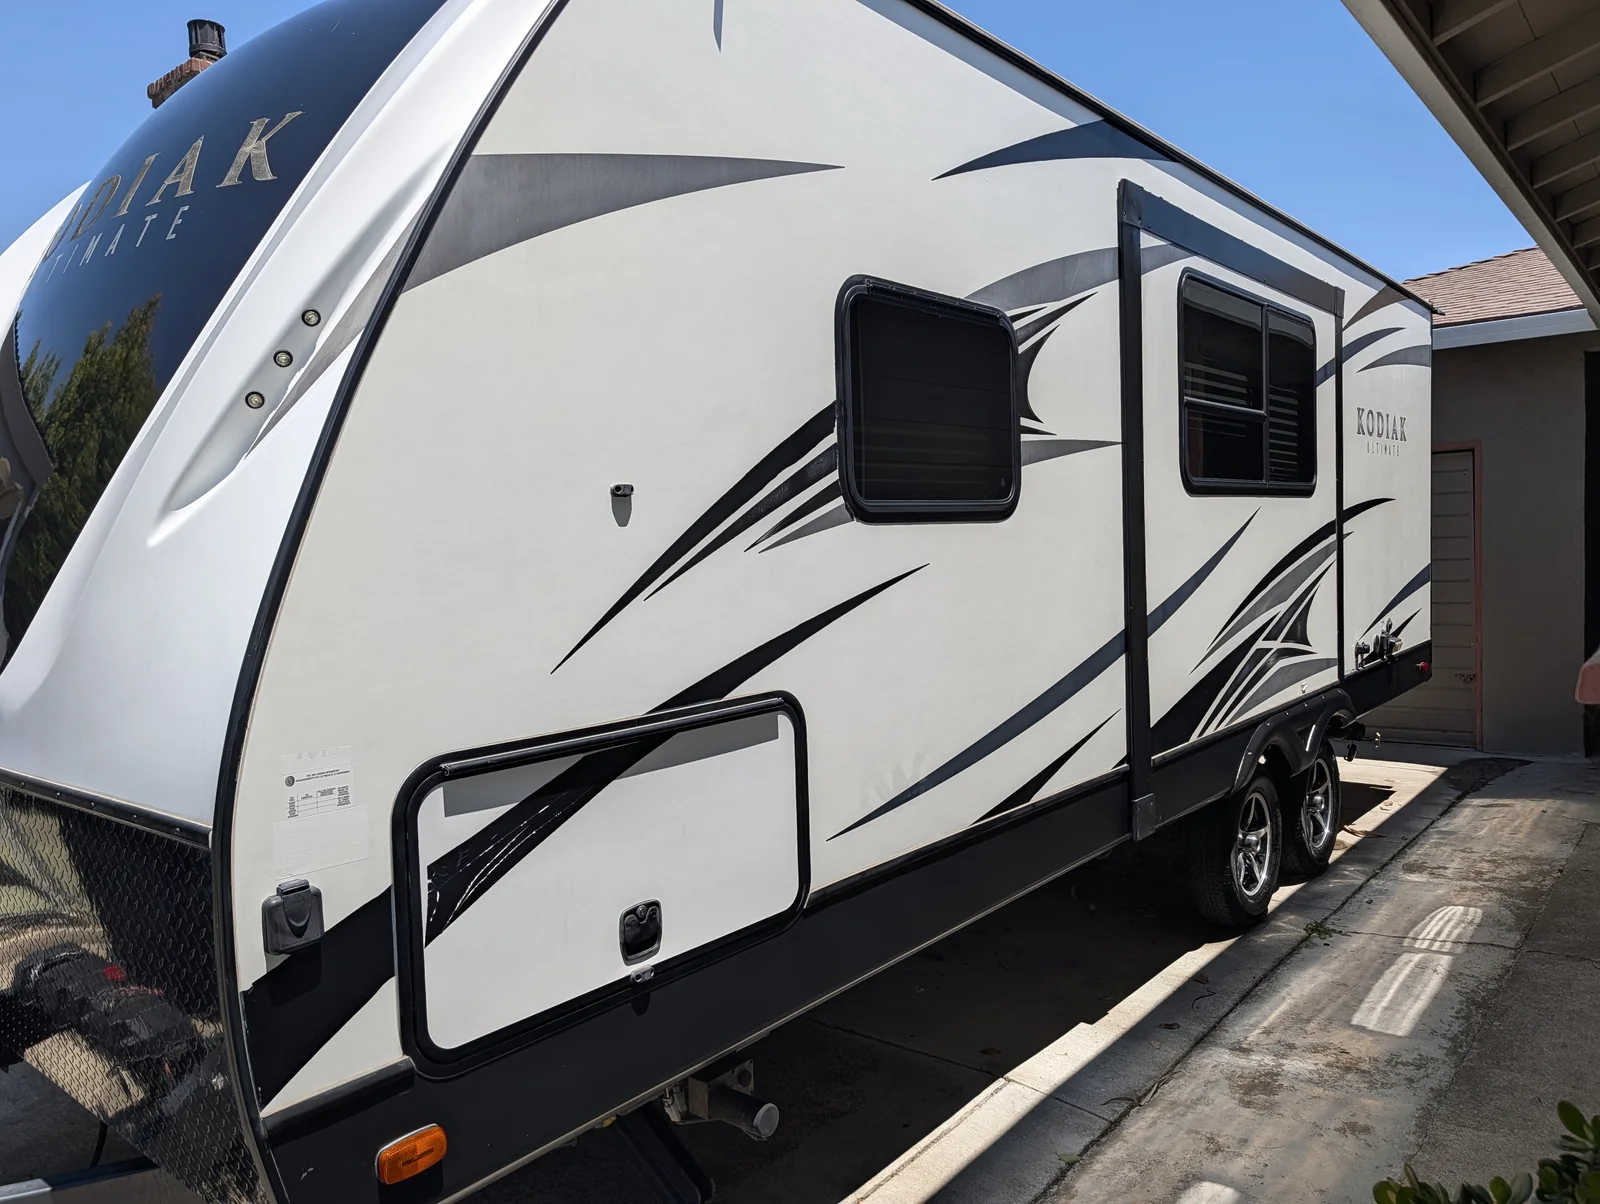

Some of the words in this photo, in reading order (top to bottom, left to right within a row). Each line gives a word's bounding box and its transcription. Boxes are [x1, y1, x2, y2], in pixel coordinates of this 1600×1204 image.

[40, 110, 305, 264] ODIAK
[43, 204, 190, 284] TIMATE
[1356, 406, 1407, 442] KODIAK
